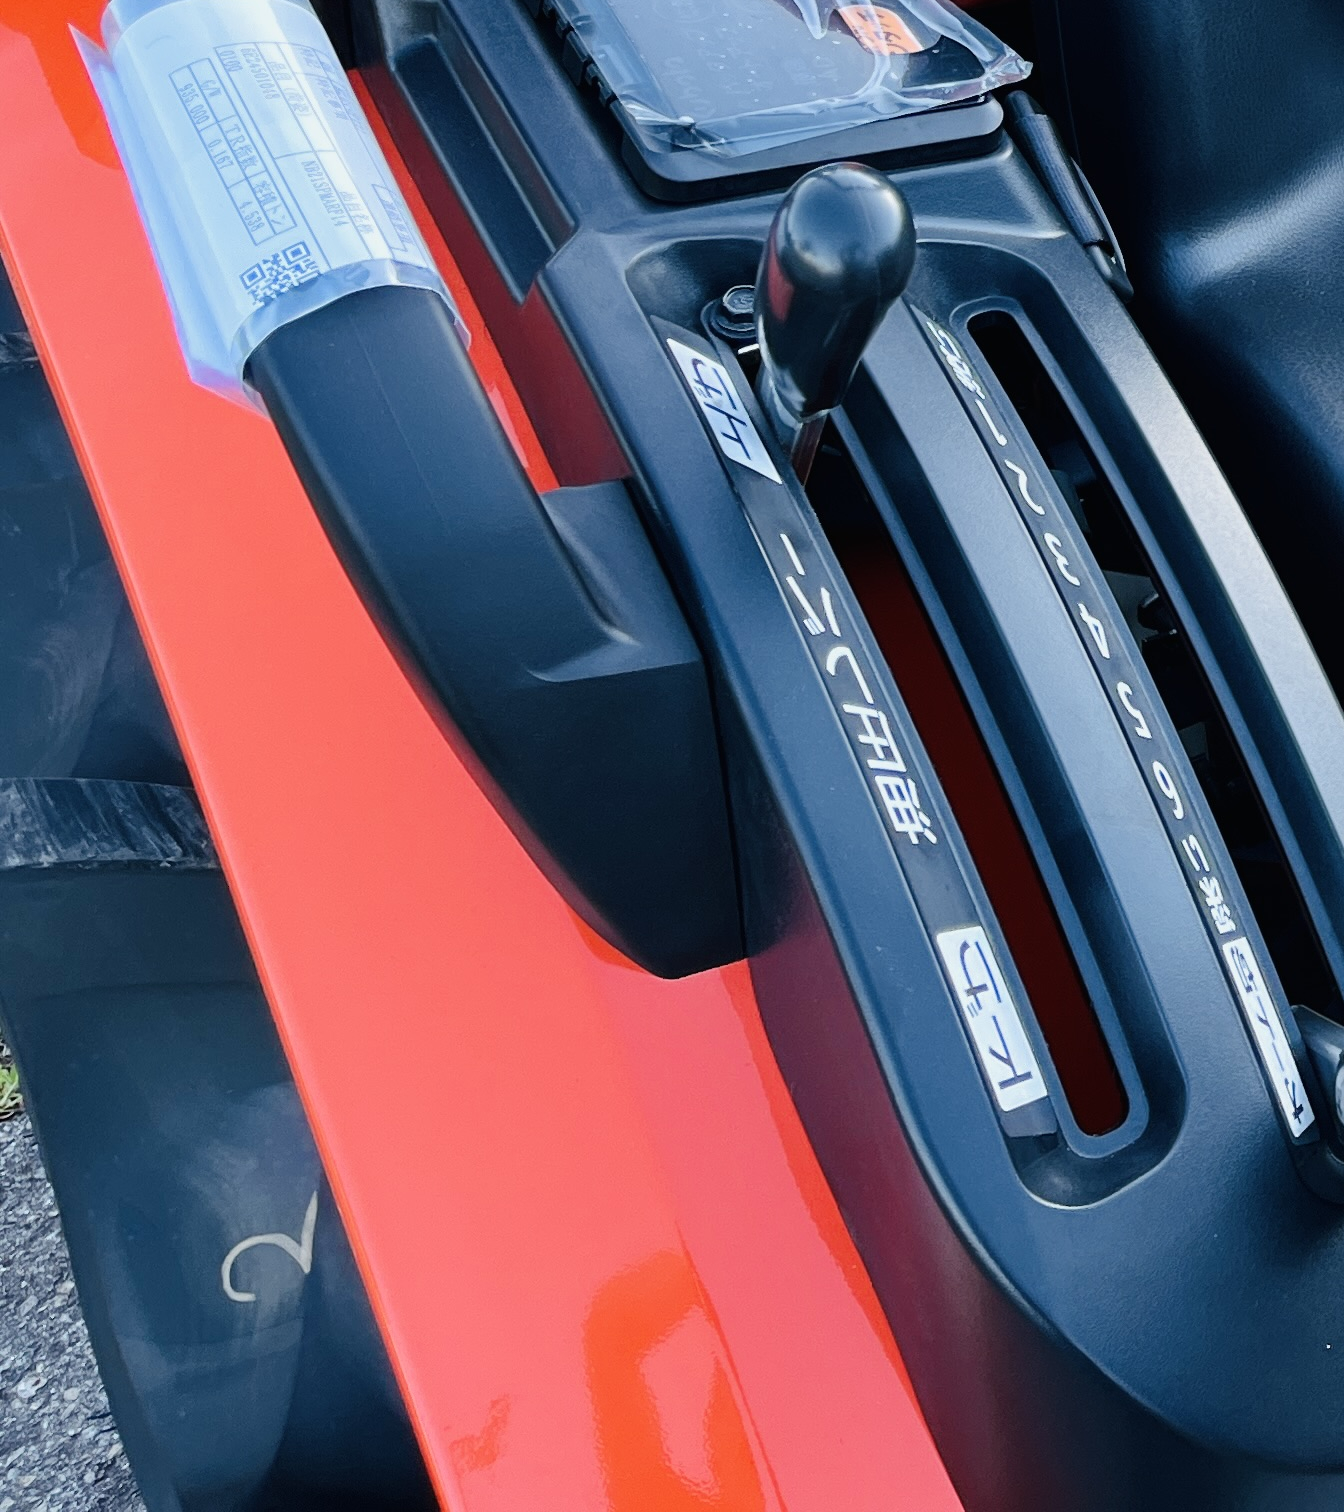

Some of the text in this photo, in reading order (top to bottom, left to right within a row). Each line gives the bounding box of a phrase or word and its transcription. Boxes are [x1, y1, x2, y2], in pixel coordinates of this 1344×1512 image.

[178, 82, 265, 232] 935.000 0.167 4.538
[692, 358, 751, 460] 上げ
[1004, 460, 1043, 515] 2
[1045, 533, 1078, 585] 3
[1080, 601, 1108, 660] 4
[778, 531, 938, 847] 油圧レバー
[1118, 681, 1153, 737] 5
[1148, 757, 1191, 821] 6
[1181, 835, 1235, 934] 深い
[957, 939, 1031, 1091] 下げ
